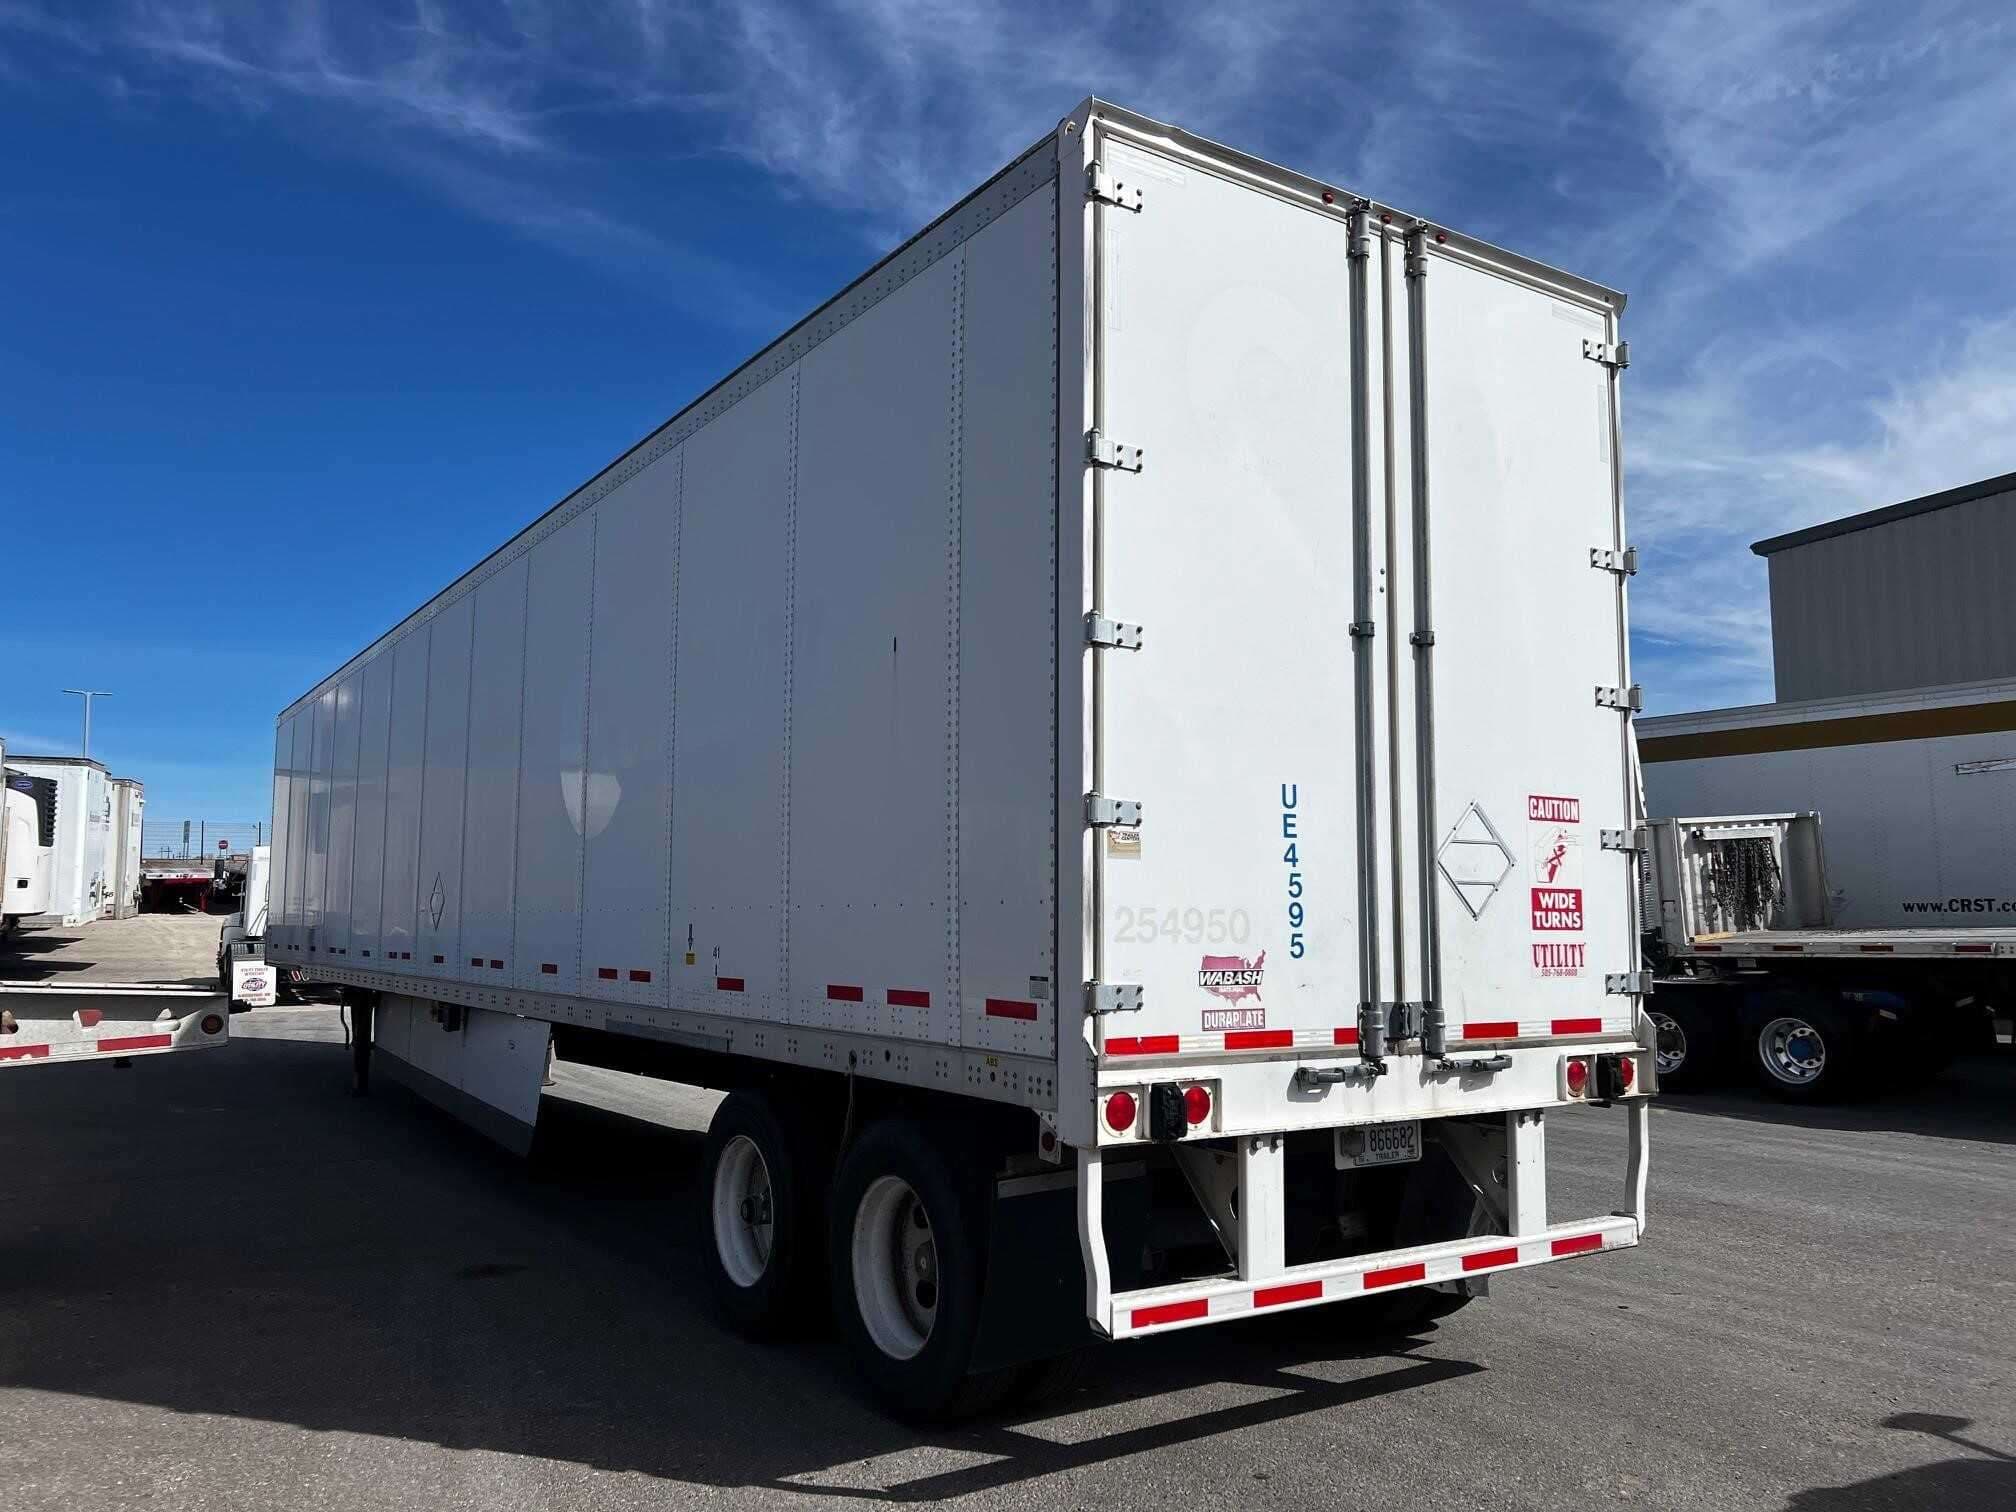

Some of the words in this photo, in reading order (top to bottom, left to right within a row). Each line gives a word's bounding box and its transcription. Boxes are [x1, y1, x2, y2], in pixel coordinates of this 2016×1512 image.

[1529, 797, 1580, 821] CAUTION
[1281, 783, 1305, 960] UE4595
[1538, 891, 1577, 910] WIDE
[1113, 906, 1250, 944] 254950
[1534, 911, 1582, 929] TURNS
[1532, 943, 1585, 968] UTILITY
[1200, 971, 1263, 986] WABASH
[1204, 1011, 1265, 1029] DURAPLATE
[1369, 1126, 1414, 1152] 866682
